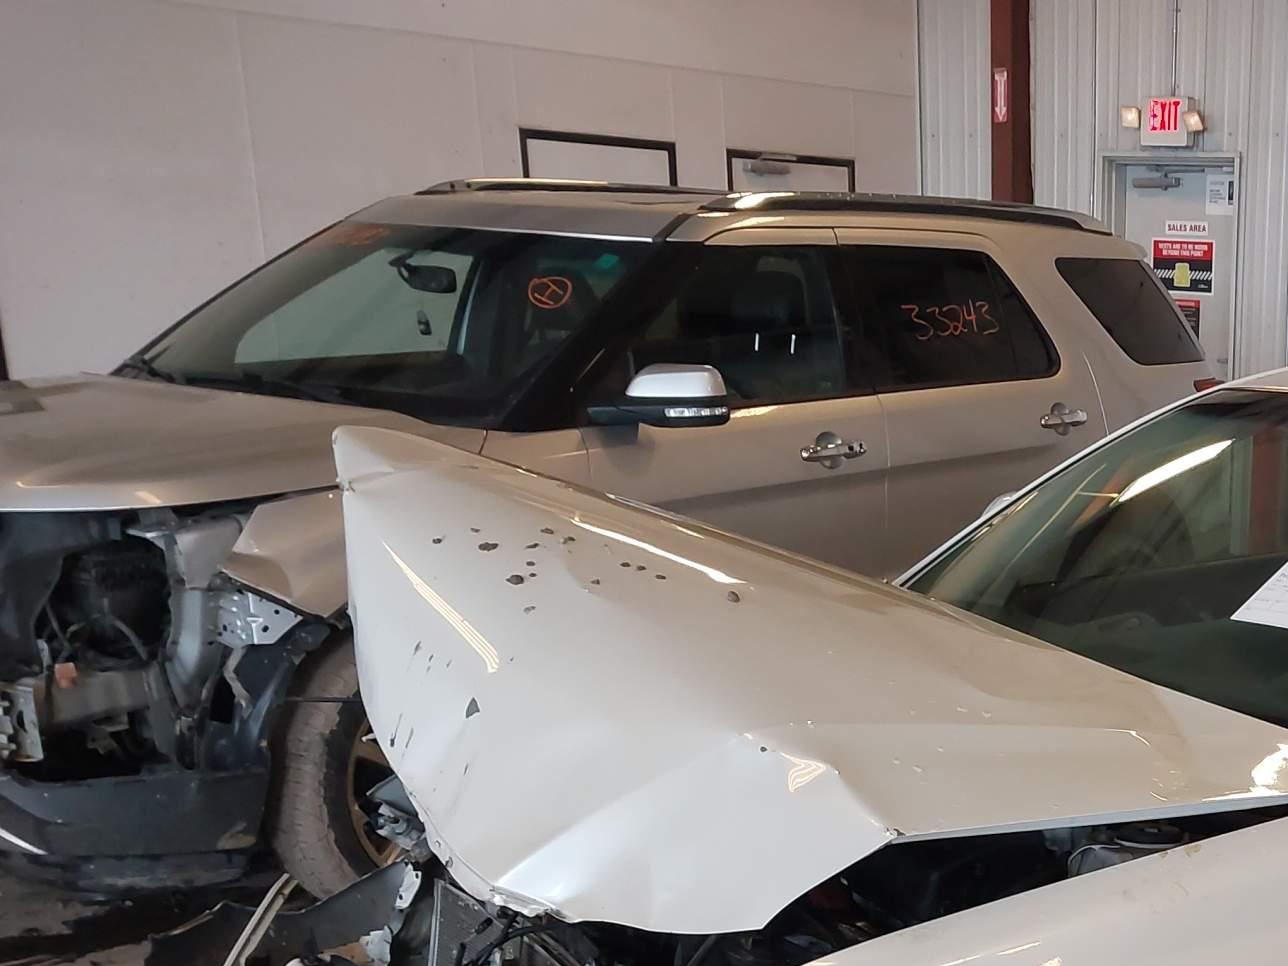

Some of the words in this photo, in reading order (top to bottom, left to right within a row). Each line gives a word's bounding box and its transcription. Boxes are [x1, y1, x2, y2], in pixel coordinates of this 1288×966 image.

[1150, 100, 1181, 131] EXIT
[1167, 223, 1188, 232] SALES
[1189, 224, 1207, 233] AREA
[900, 298, 1000, 340] 33243
